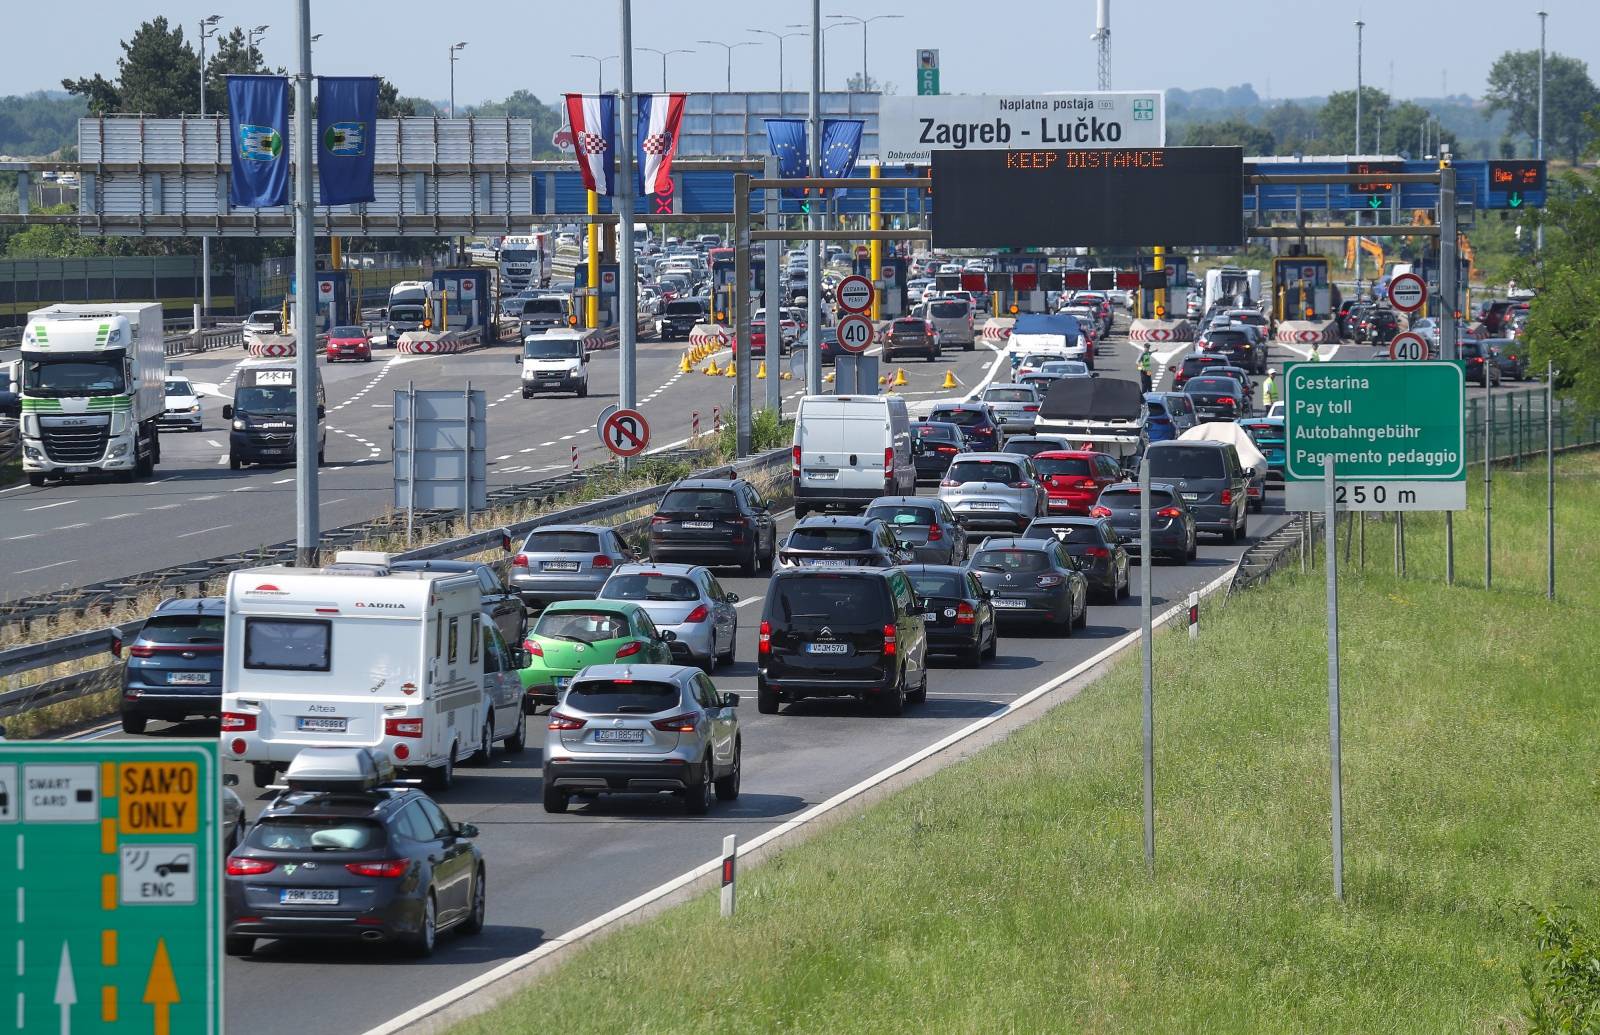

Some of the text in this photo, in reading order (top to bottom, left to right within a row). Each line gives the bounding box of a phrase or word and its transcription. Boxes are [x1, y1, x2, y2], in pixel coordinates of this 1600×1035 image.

[1000, 99, 1048, 111] Naplatna
[1053, 98, 1094, 110] postaja
[919, 118, 1011, 149] Zagreb
[1041, 117, 1122, 143] Lučko
[887, 150, 931, 159] Dobrodošli
[1007, 151, 1164, 169] KEEP DISTANCE
[845, 325, 866, 342] 40
[1398, 343, 1419, 360] 40
[1295, 376, 1370, 390] Cestarina
[1296, 400, 1352, 417] Pay toll
[1295, 425, 1421, 442] Autobahngebühr
[1388, 449, 1457, 466] pedaggio
[1336, 486, 1416, 504] 250 m
[308, 704, 336, 713] Altea
[28, 778, 72, 790] SMART
[124, 768, 193, 795] SAMO
[33, 795, 68, 807] CARD
[129, 801, 188, 829] ONLY
[141, 882, 175, 898] ENC
[312, 890, 335, 900] 9326
